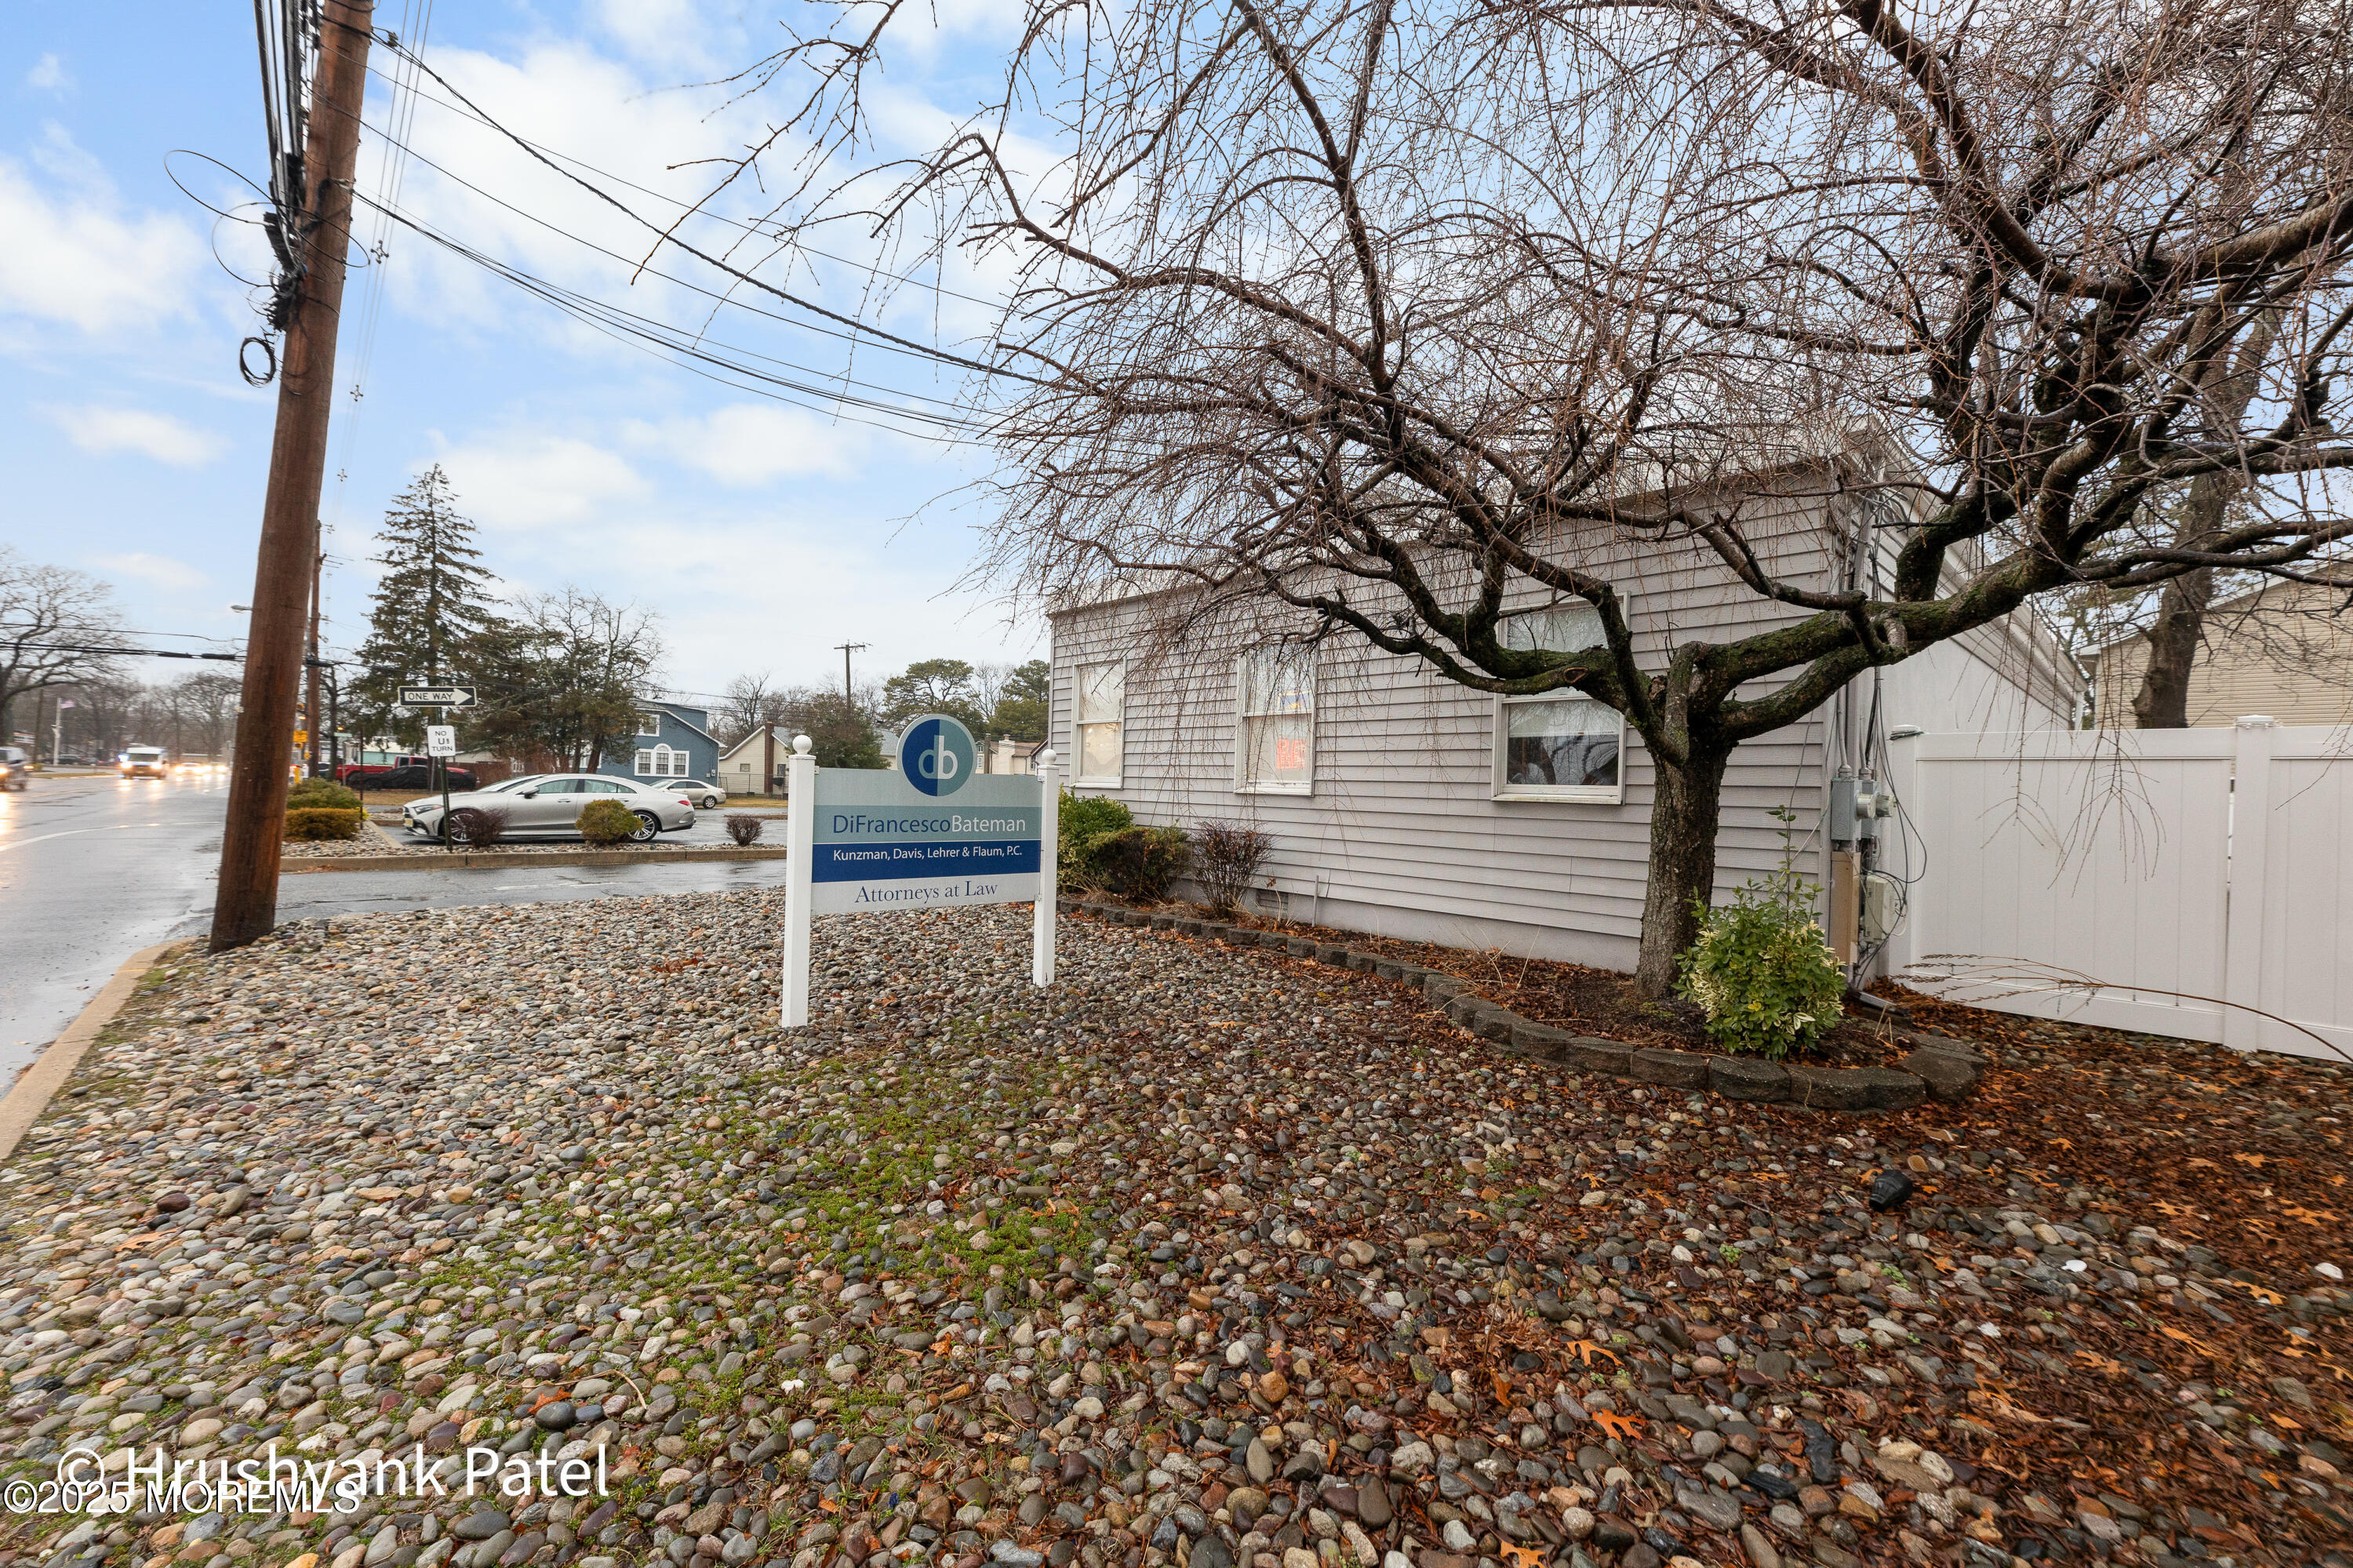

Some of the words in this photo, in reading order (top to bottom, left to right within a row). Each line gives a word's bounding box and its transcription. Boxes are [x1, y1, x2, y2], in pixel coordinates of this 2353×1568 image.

[833, 849, 891, 861] Kunzman,
[893, 848, 925, 860] Davis,
[927, 847, 961, 858] Lehrer
[962, 846, 970, 857] &
[973, 846, 1005, 857] Flaum,
[1006, 846, 1023, 856] P.C.
[854, 886, 940, 904] Attorneys
[944, 884, 960, 897] at
[965, 880, 998, 897] Law
